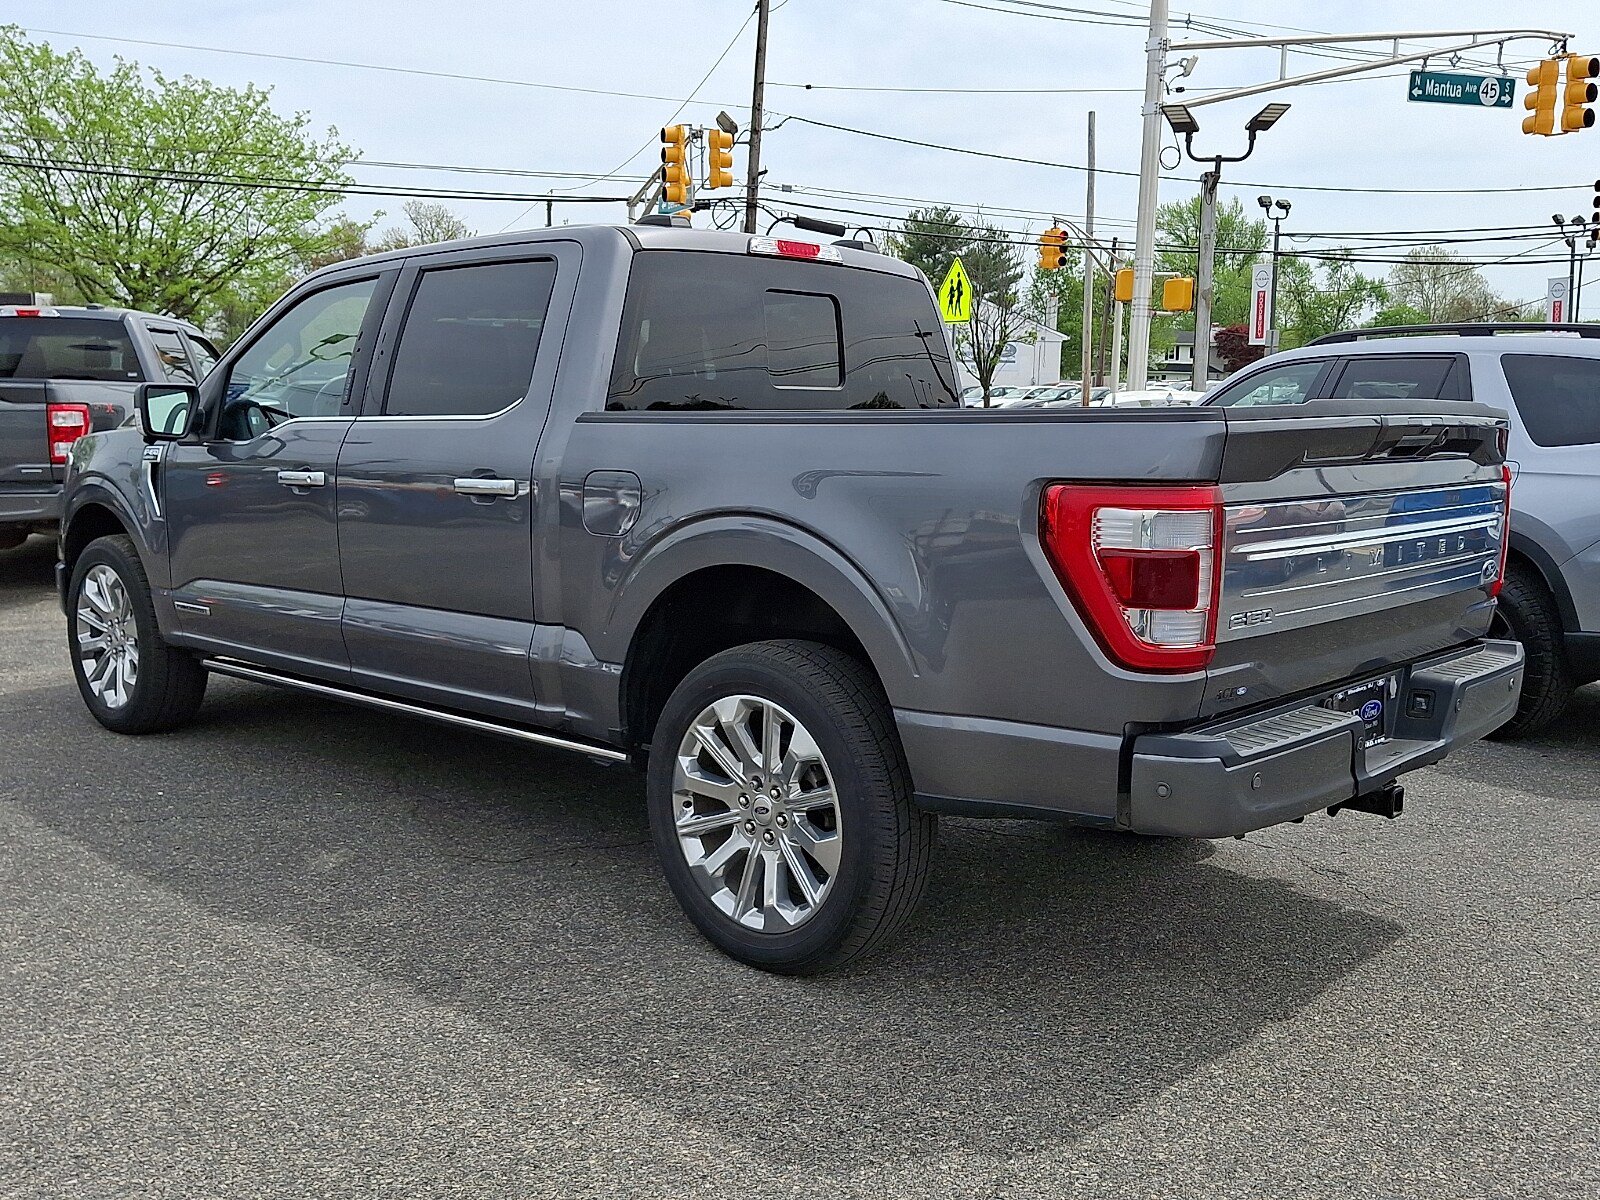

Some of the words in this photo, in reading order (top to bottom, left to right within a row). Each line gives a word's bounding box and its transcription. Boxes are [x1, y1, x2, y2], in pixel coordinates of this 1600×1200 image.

[1415, 75, 1422, 86] N
[1425, 79, 1462, 98] Mantua
[1465, 82, 1478, 93] Ave
[1505, 81, 1511, 93] S
[1481, 82, 1498, 99] 45
[1257, 292, 1265, 338] WOODBURY
[1317, 535, 1465, 574] LIMITED
